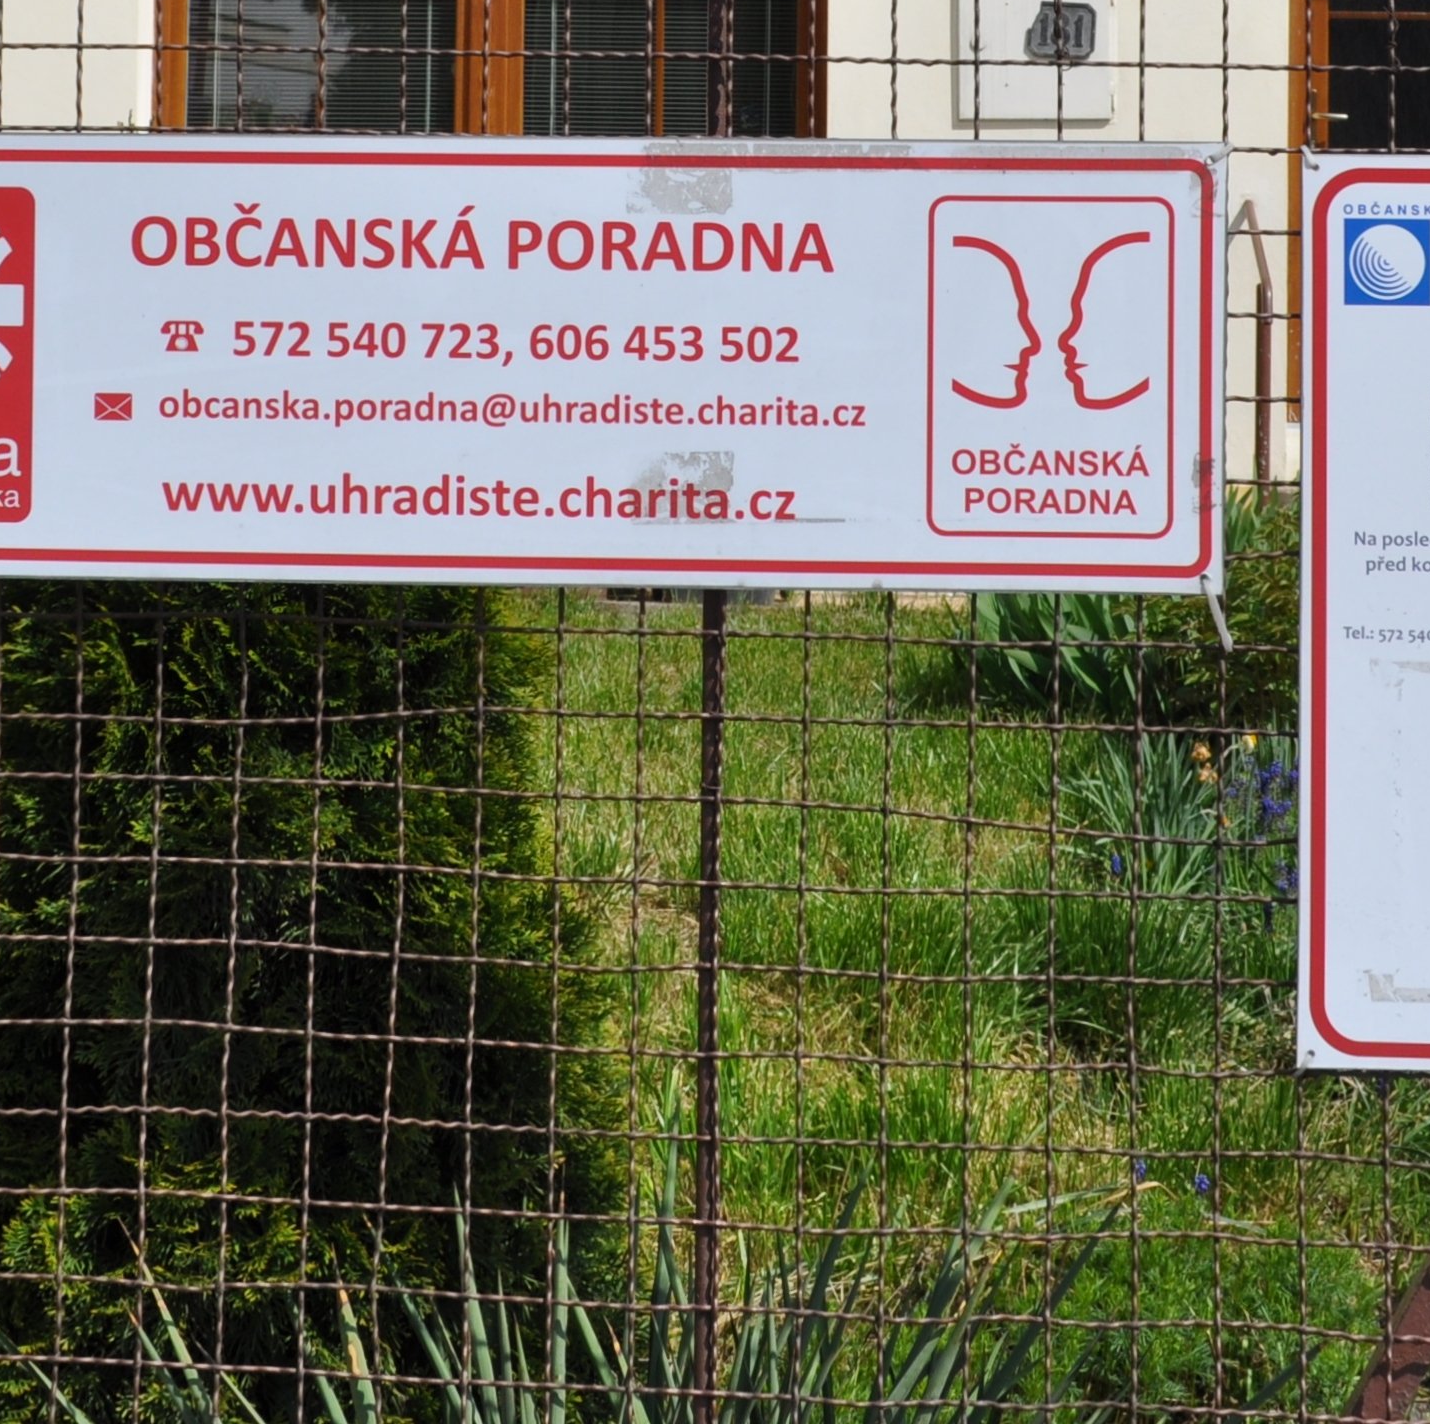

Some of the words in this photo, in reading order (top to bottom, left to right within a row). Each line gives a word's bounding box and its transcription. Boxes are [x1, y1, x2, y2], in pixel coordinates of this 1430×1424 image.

[1038, 13, 1083, 48] 181
[132, 203, 484, 269] OBČANSKÁ
[509, 221, 834, 272] PORADNA
[234, 321, 310, 356] 572
[327, 323, 405, 358] 540
[422, 323, 512, 366] 723,
[530, 324, 609, 360] 606
[624, 326, 703, 361] 453
[721, 327, 799, 362] 502
[159, 389, 865, 427] obcanska.poradna@uhradiste.charita.cz
[952, 444, 1149, 476] OBČANSKÁ
[162, 473, 795, 520] www.uhradiste.charita.cz
[965, 488, 1137, 515] PORADNA
[1355, 531, 1376, 545] Na
[1366, 556, 1406, 575] před
[1343, 626, 1374, 639] Tel.:
[1379, 629, 1403, 643] 572
